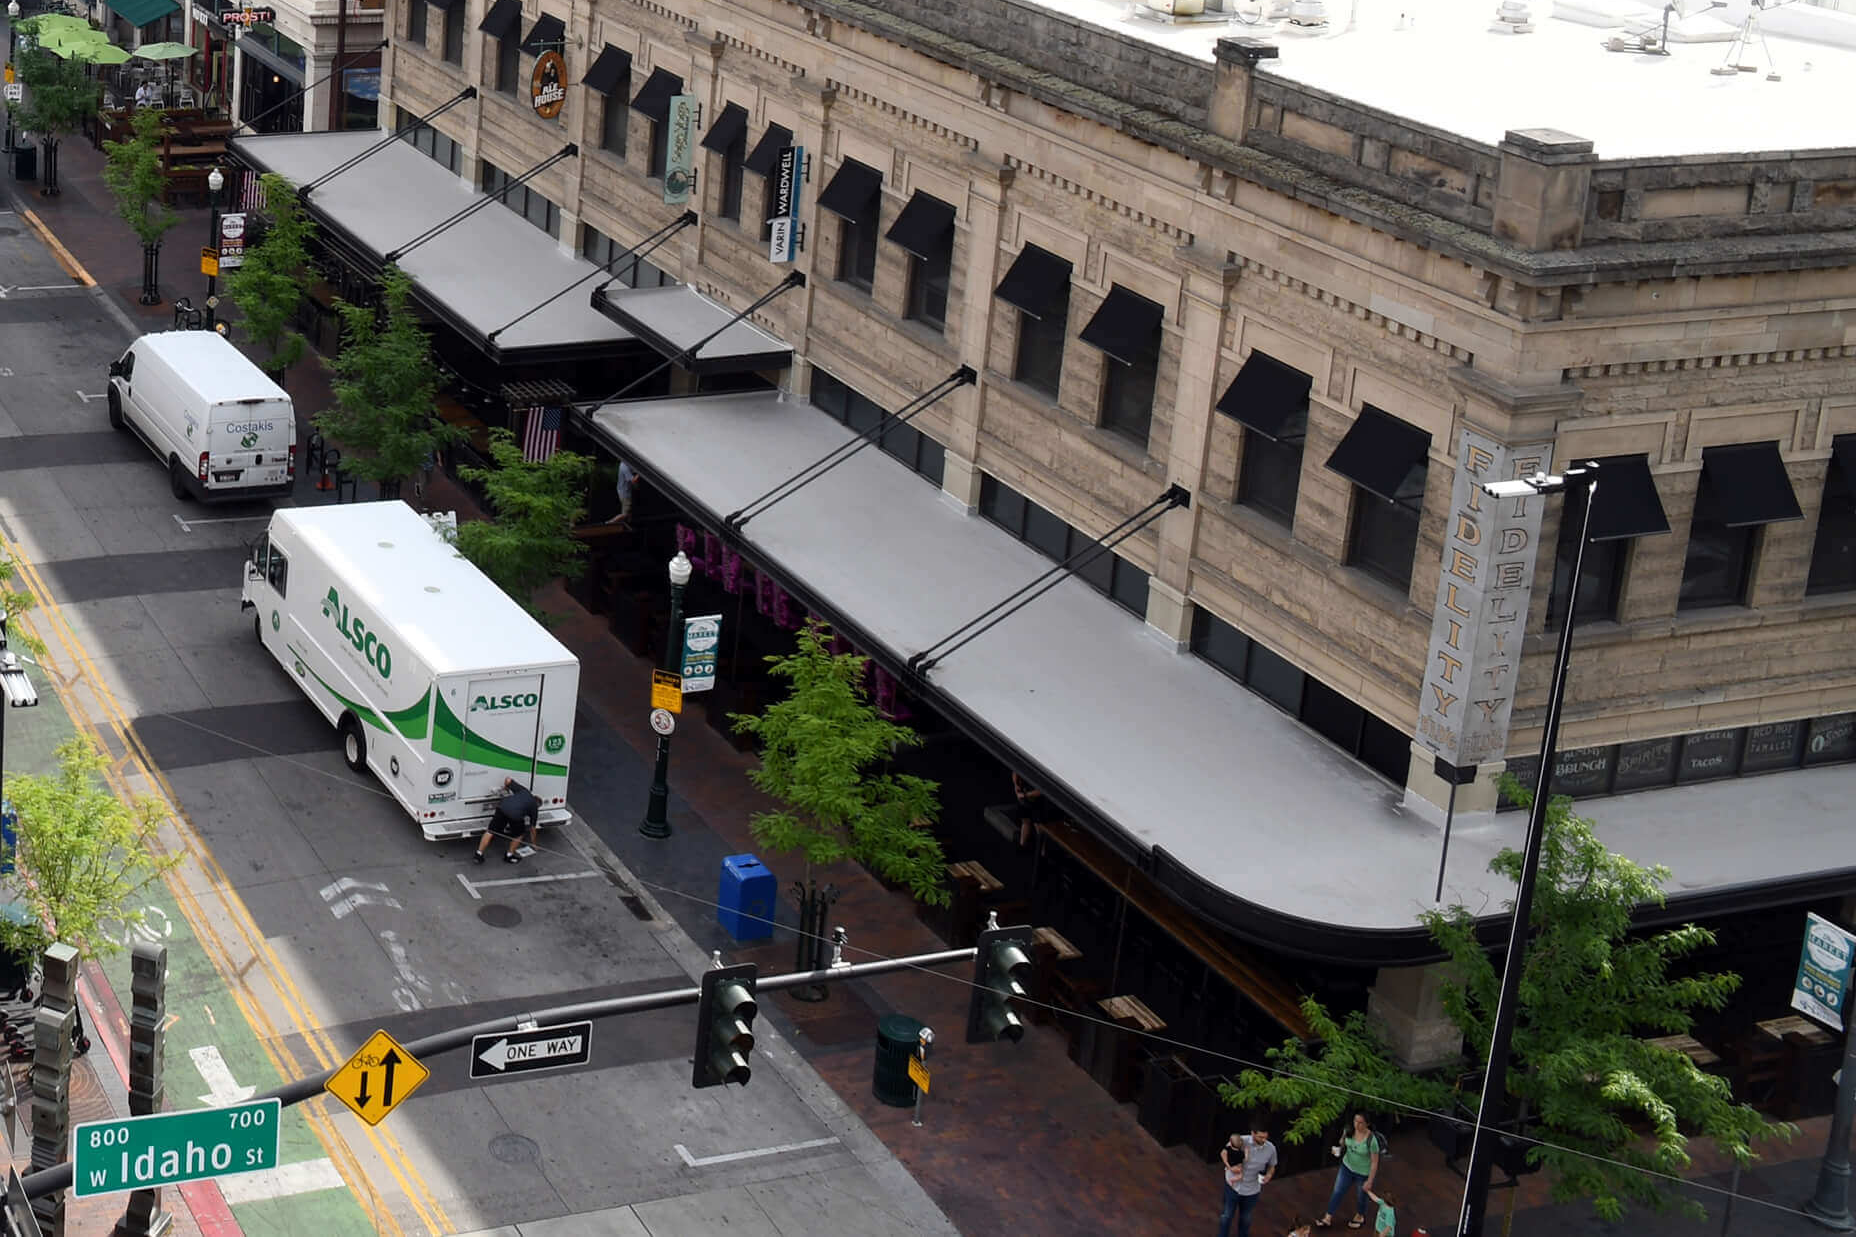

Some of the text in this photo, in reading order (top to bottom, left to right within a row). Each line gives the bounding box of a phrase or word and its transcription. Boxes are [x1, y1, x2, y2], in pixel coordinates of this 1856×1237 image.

[223, 11, 271, 23] PROST!
[534, 88, 565, 108] HOUSE
[542, 83, 559, 95] ALE
[775, 151, 793, 256] VARIN WARDWELL
[226, 420, 274, 434] Costakis
[1430, 444, 1495, 718] FIDELITY
[320, 586, 392, 679] ALSCO
[470, 692, 539, 712] ALSCO
[506, 1037, 577, 1060] ONE WAY
[228, 1109, 265, 1130] 700
[90, 1127, 130, 1148] 800
[89, 1140, 264, 1187] W Idaho St
